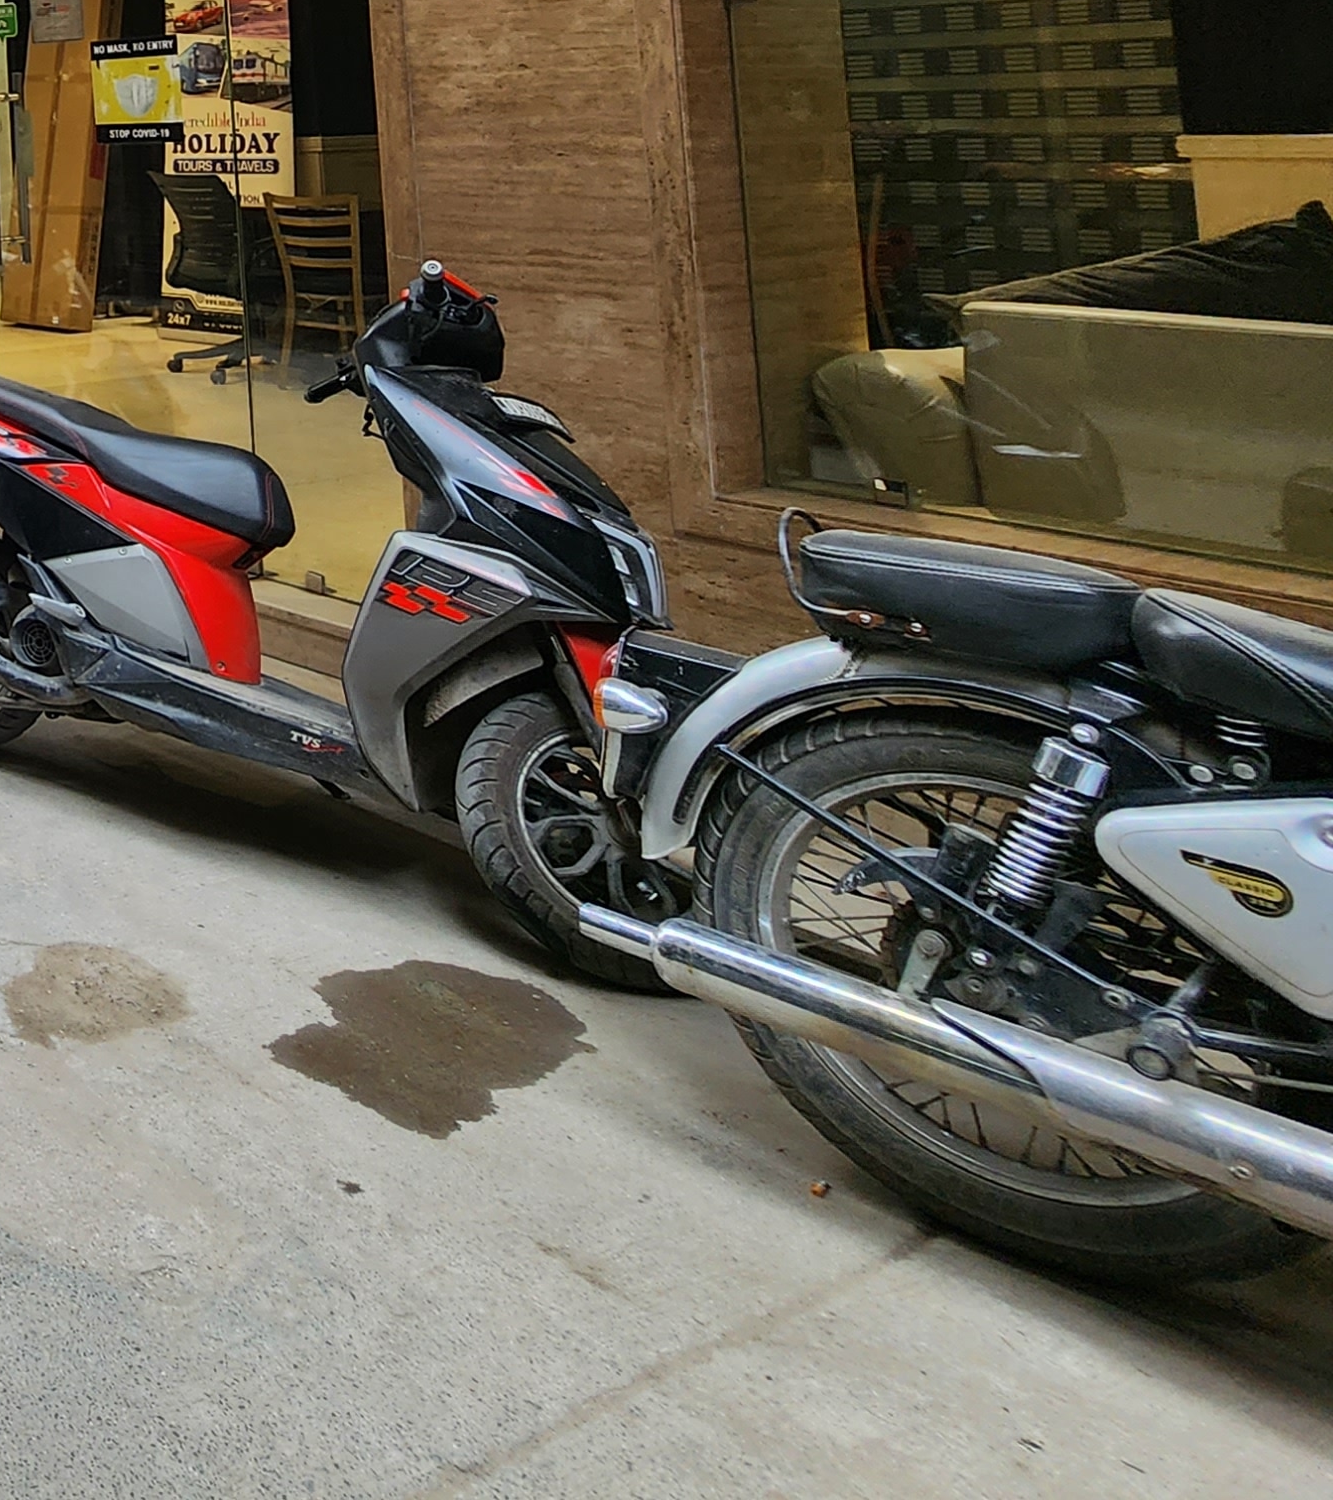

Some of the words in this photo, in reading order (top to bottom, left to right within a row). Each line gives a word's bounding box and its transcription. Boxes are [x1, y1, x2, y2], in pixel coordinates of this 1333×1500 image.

[93, 44, 104, 55] NO
[146, 39, 173, 51] ENTRY
[109, 129, 130, 139] STOP
[132, 127, 171, 139] COVID-19
[177, 160, 213, 172] TOURS
[215, 162, 223, 172] &
[225, 160, 274, 172] TRAVELS
[167, 312, 191, 326] 24x7
[290, 730, 322, 749] TVS
